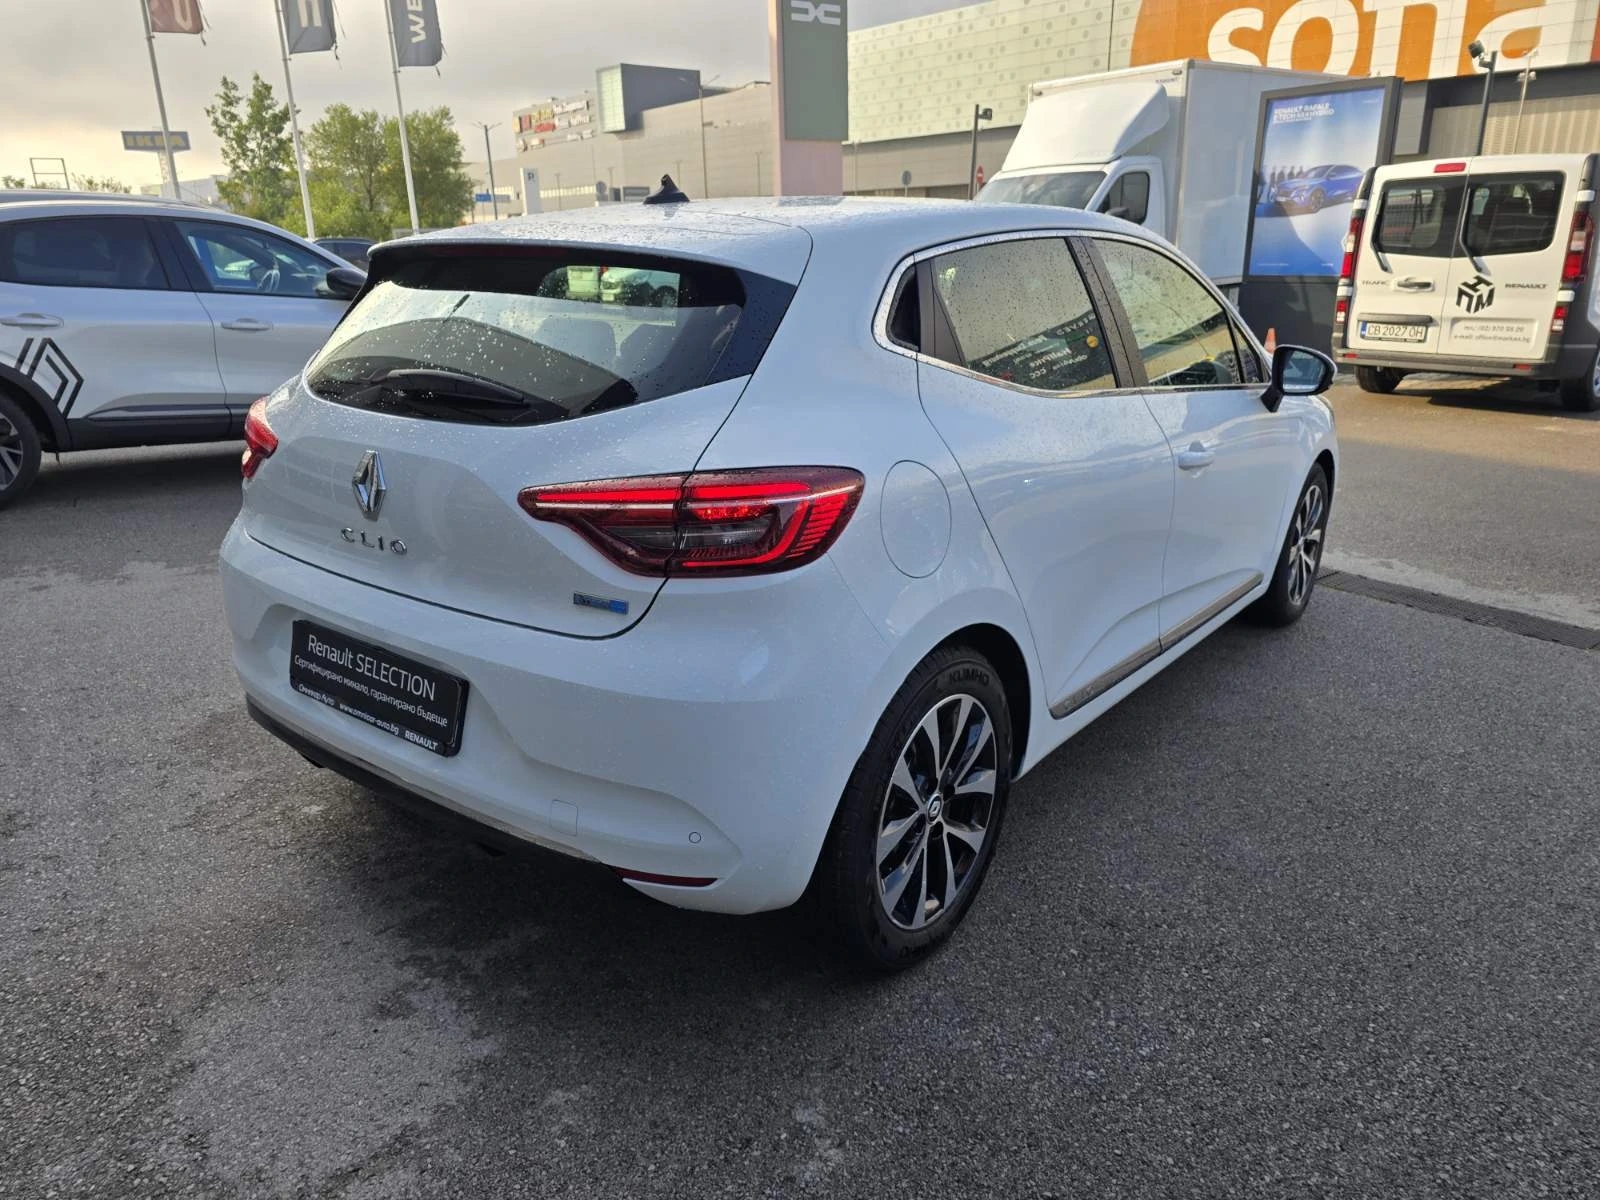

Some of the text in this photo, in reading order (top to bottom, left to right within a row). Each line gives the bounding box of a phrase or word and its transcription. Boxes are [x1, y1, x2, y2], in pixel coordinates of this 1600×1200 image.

[125, 135, 185, 146] IKEA
[1382, 325, 1408, 337] 2027
[341, 527, 408, 555] CLIO
[308, 634, 436, 701] Renault SELECTION
[294, 654, 343, 684] Сертифицирано
[370, 687, 416, 715] гарантирано
[416, 704, 448, 728] бъдеще
[405, 730, 439, 751] RENAULT
